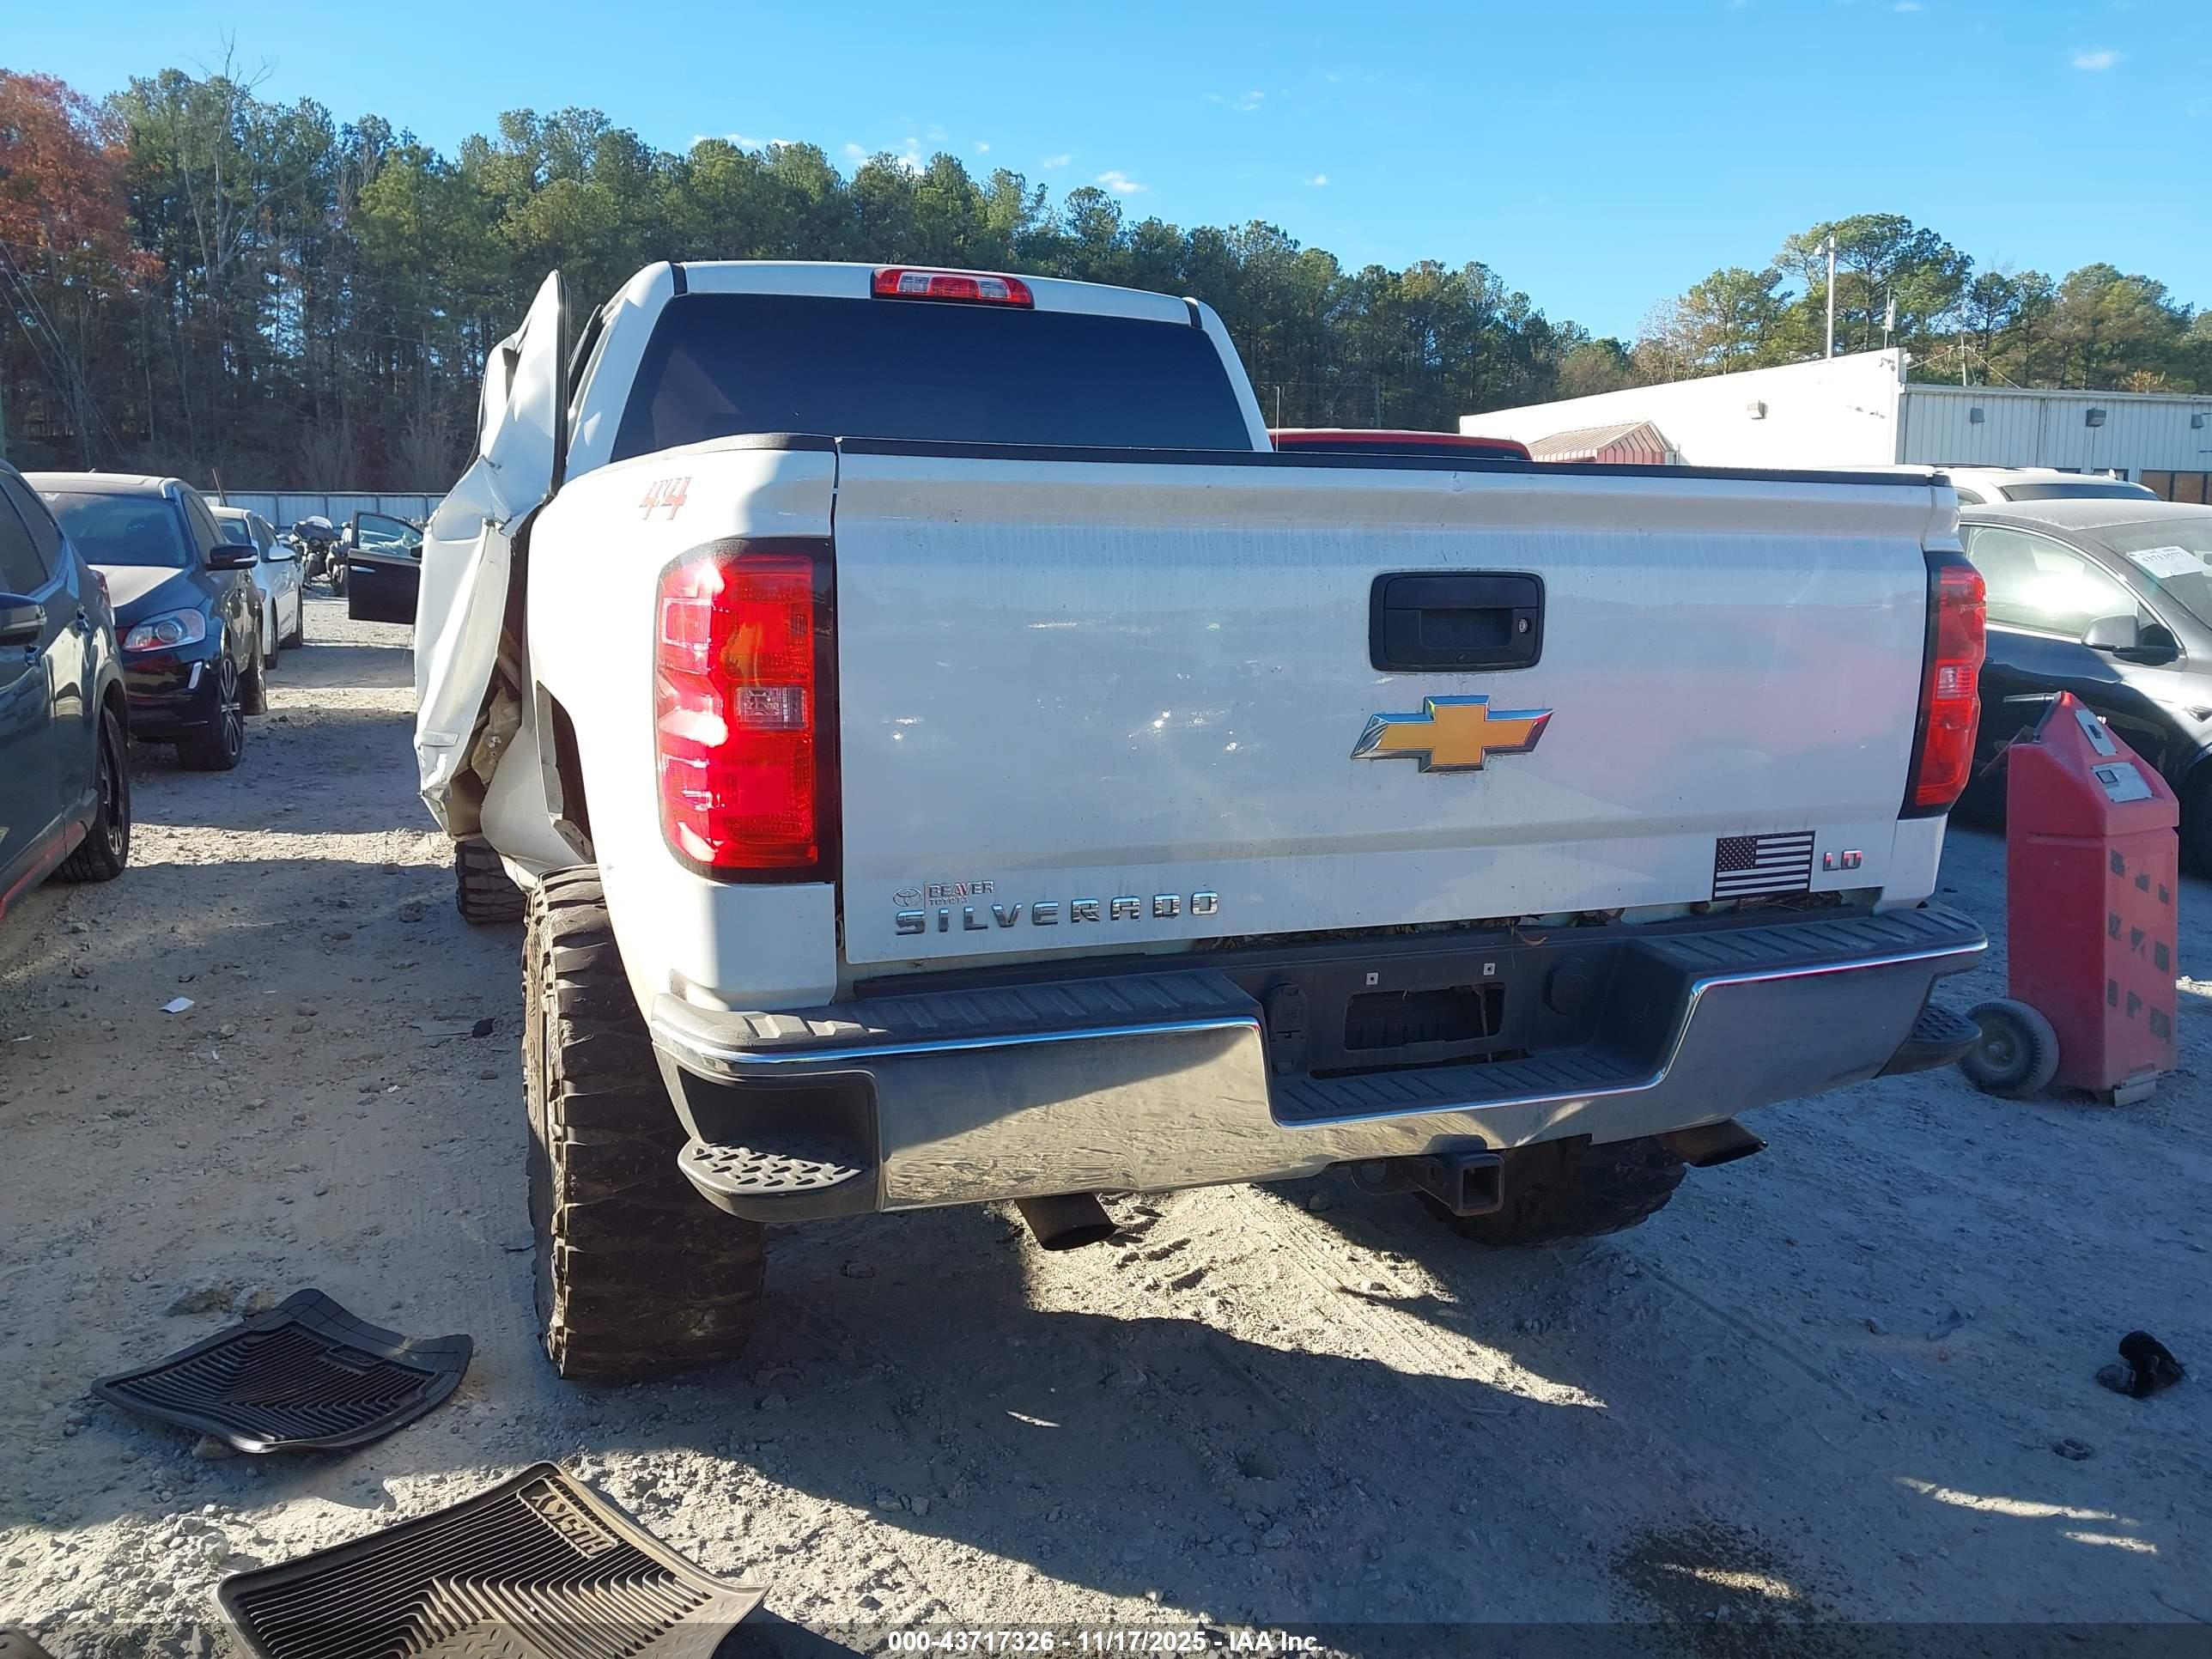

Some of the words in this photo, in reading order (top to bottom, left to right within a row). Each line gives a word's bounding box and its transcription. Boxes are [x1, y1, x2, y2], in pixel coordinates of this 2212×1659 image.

[1822, 850, 1863, 872] LD
[928, 880, 994, 898] BEAVER
[929, 896, 969, 906] TOYOTA
[895, 890, 1219, 936] SILVERADO
[531, 1492, 612, 1554] HUSKY
